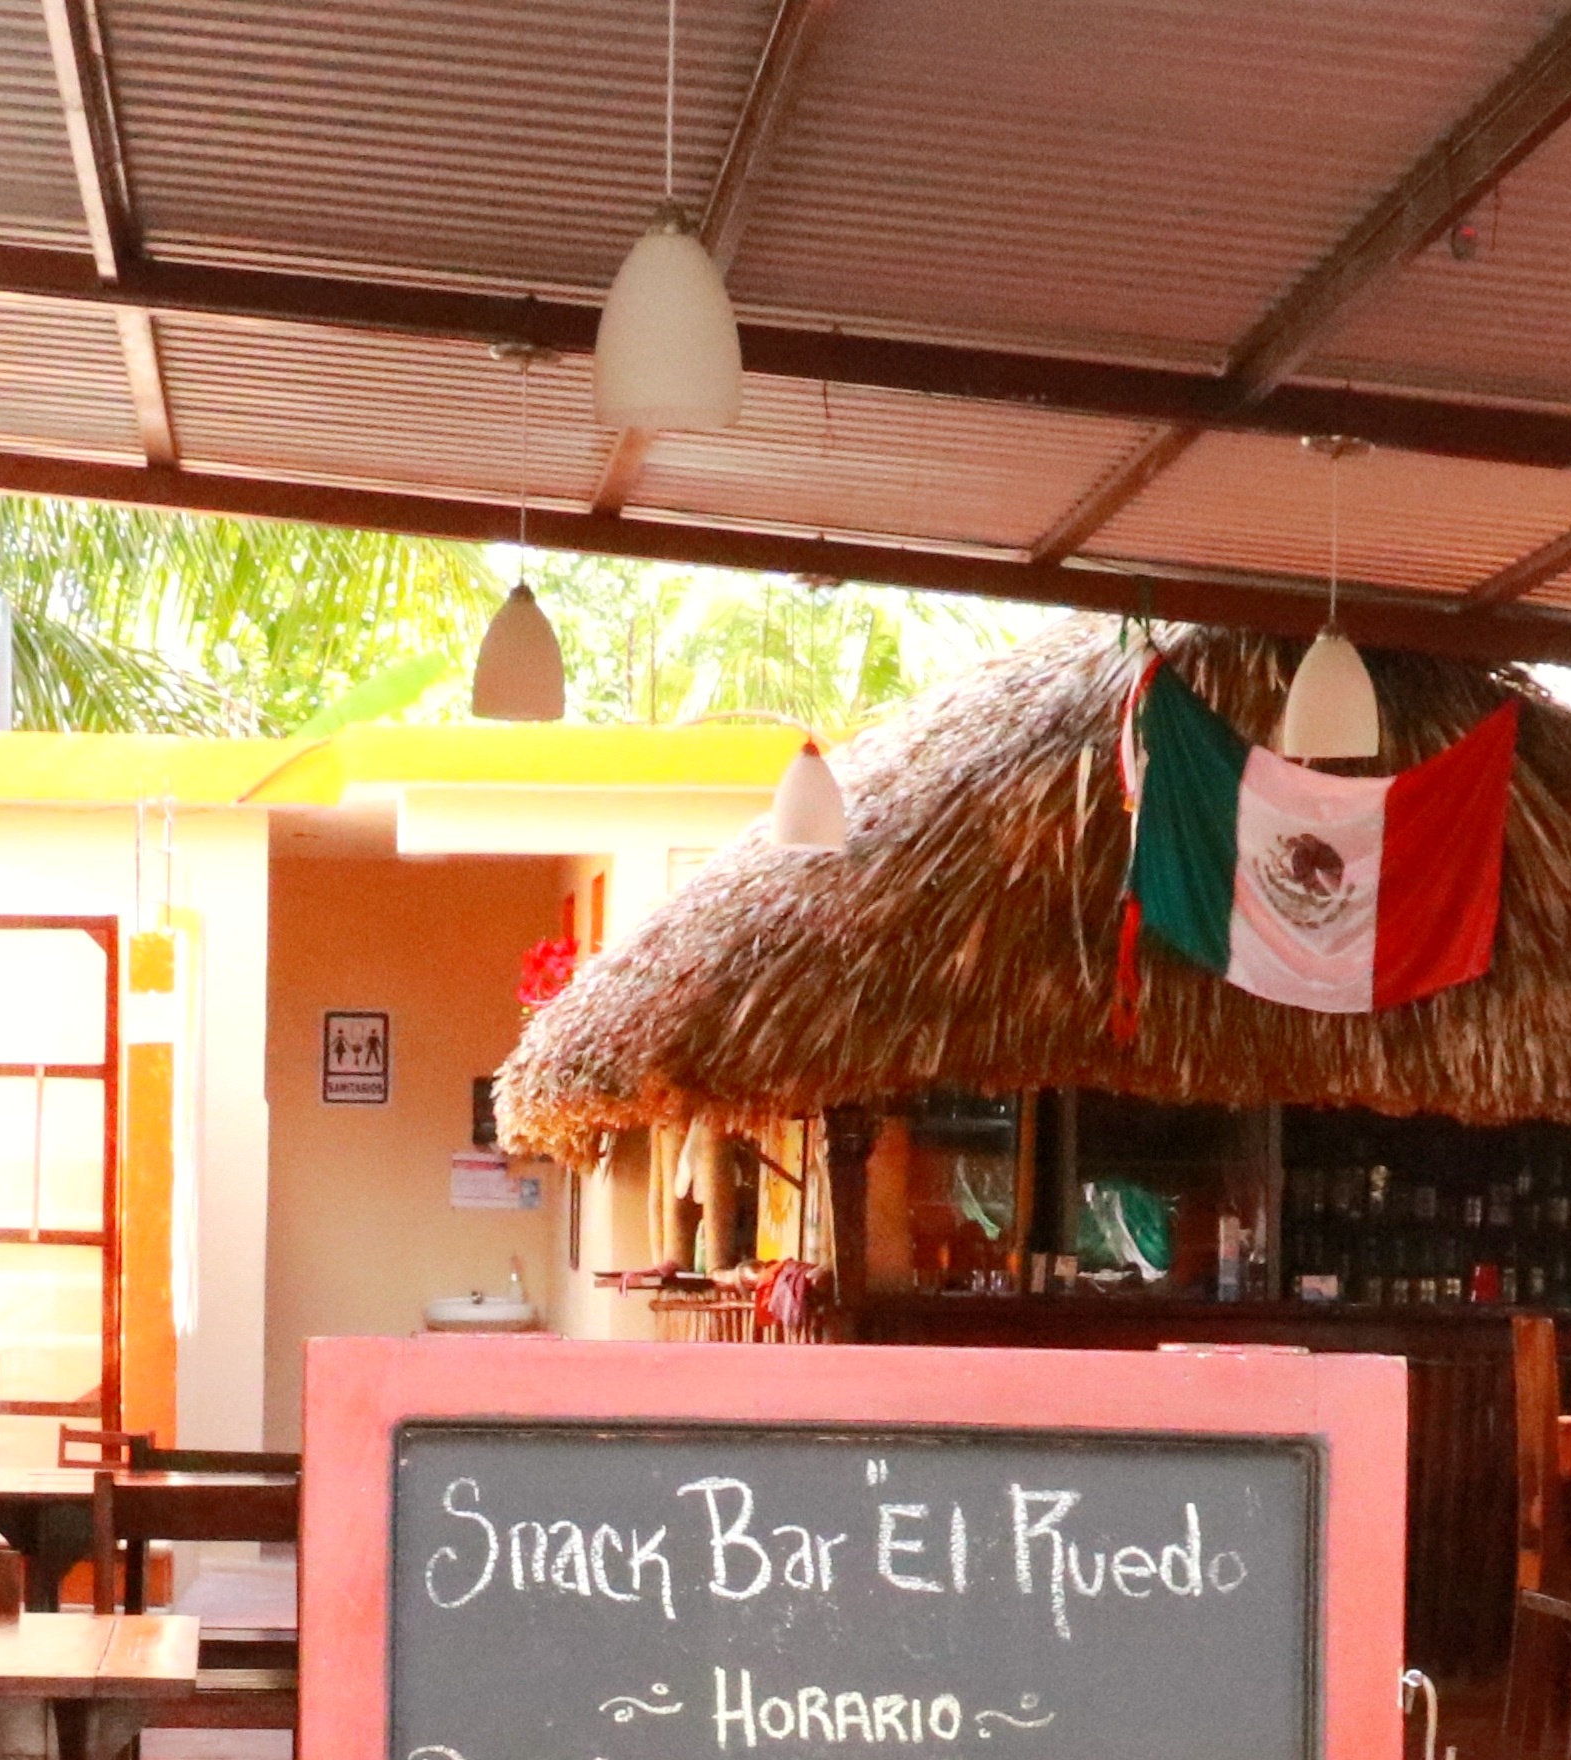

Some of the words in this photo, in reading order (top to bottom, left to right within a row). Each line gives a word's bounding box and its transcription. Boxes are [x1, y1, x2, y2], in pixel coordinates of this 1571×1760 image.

[425, 1476, 676, 1620] Snack
[676, 1476, 847, 1601] Bar
[711, 1666, 963, 1749] HORARIO
